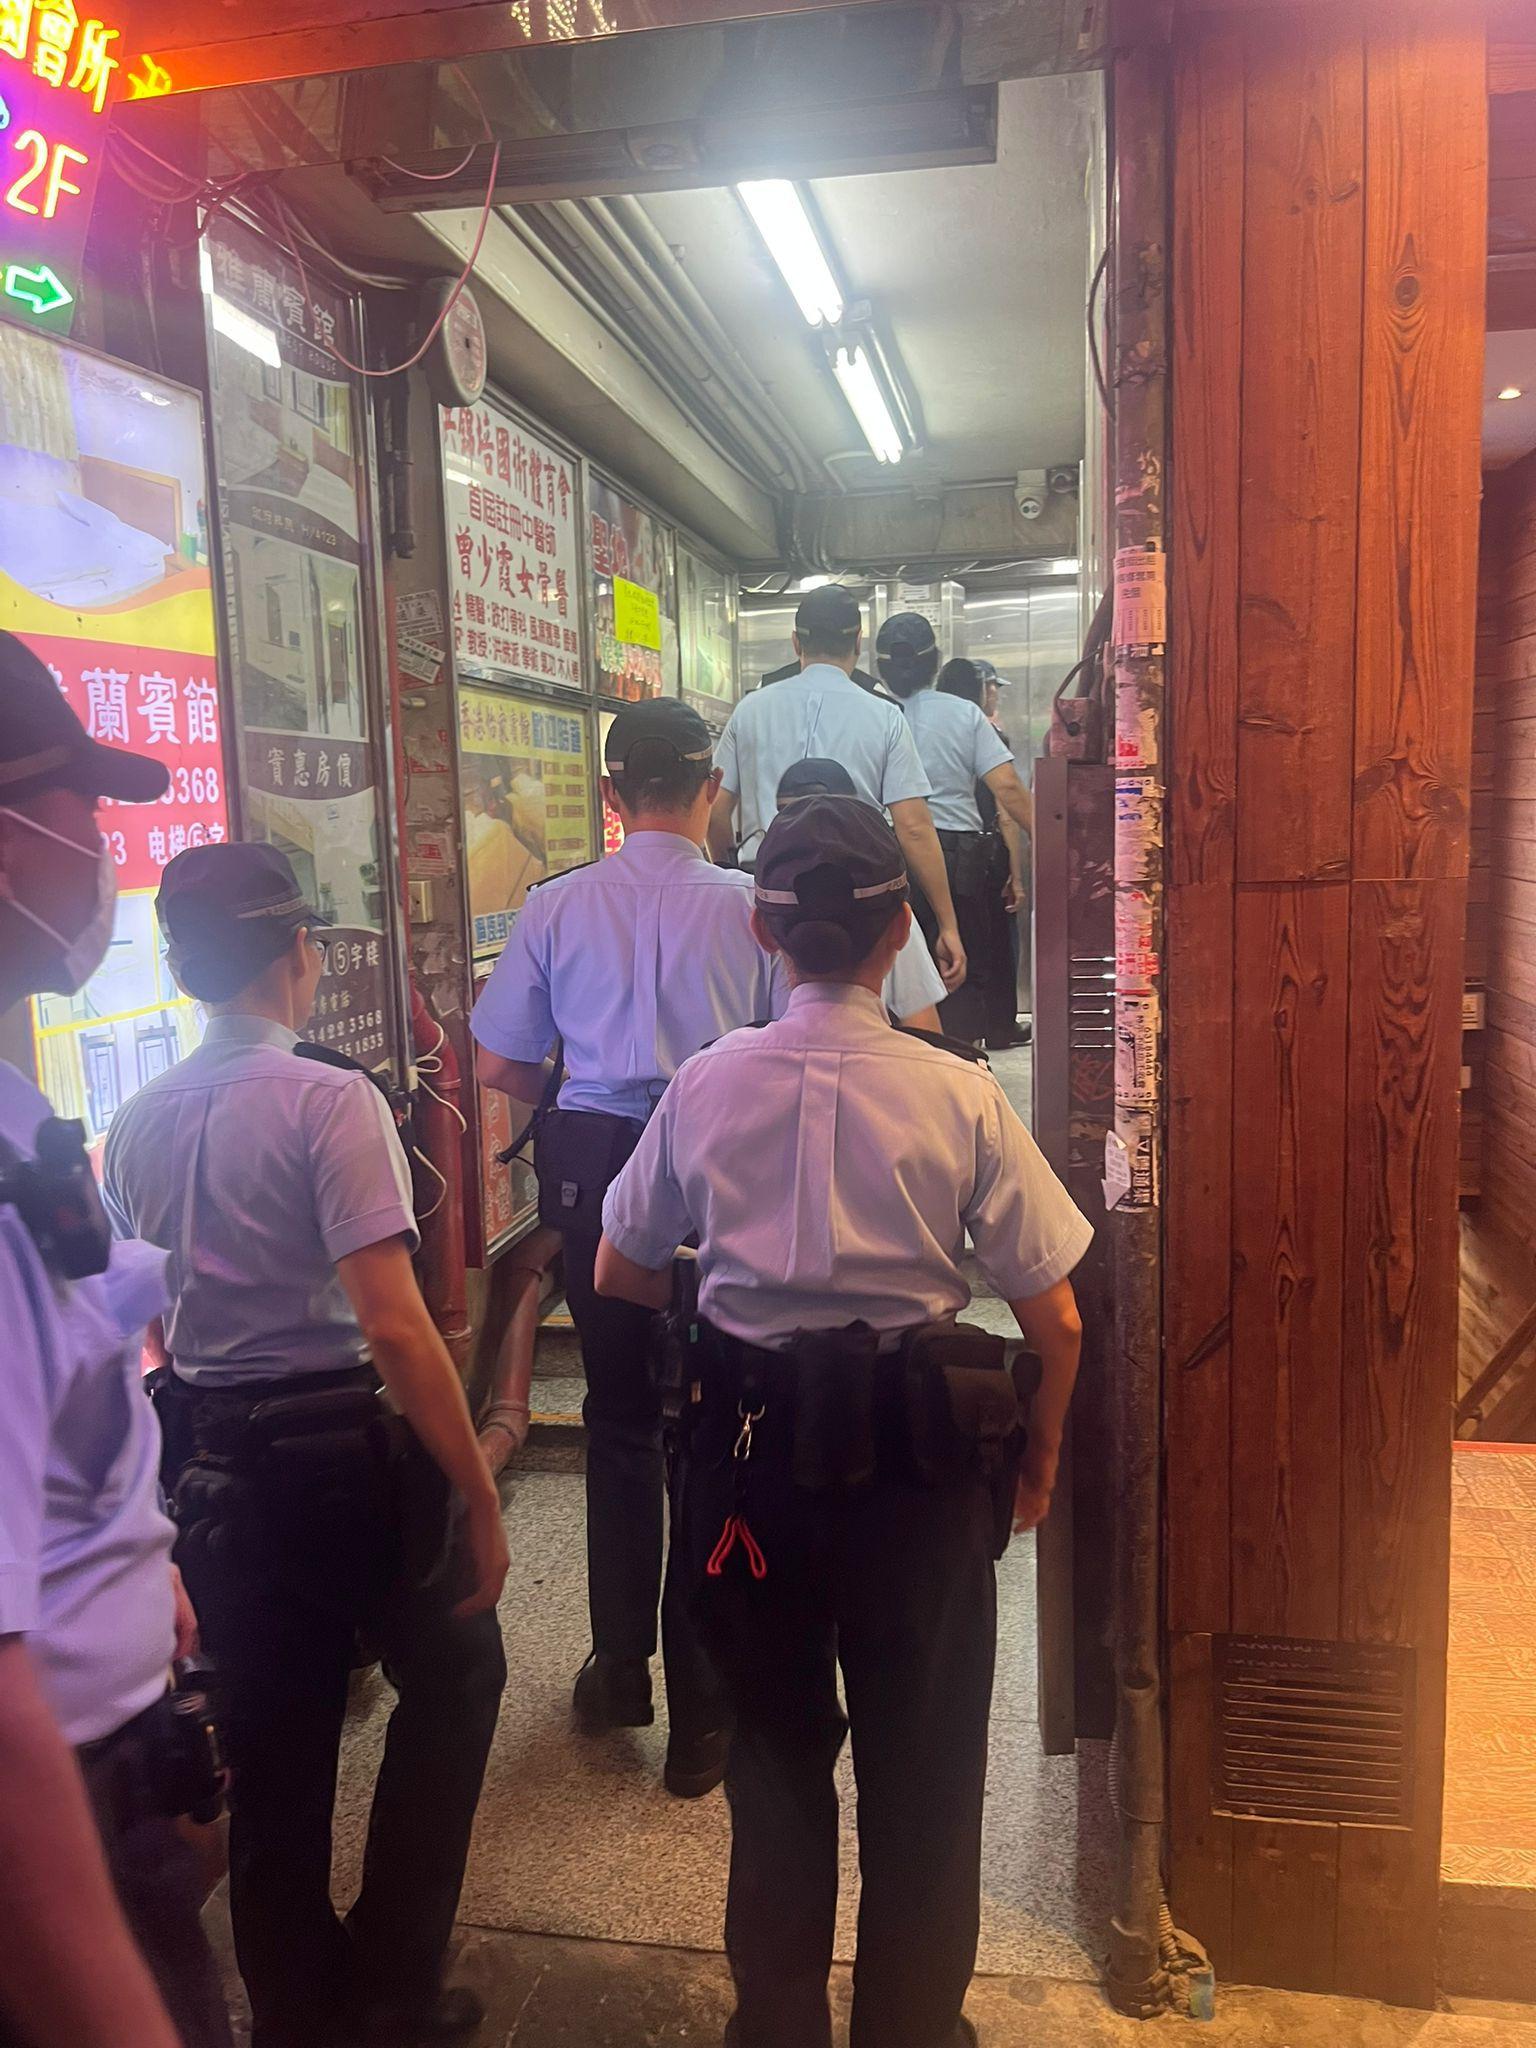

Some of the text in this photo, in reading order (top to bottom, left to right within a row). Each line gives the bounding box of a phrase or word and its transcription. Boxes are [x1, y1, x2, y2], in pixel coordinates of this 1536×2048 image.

[6, 130, 89, 218] 2F
[468, 481, 557, 558] 首屆註冊中醫師
[46, 663, 218, 745] 蘭賓館
[348, 1009, 383, 1034] 3368
